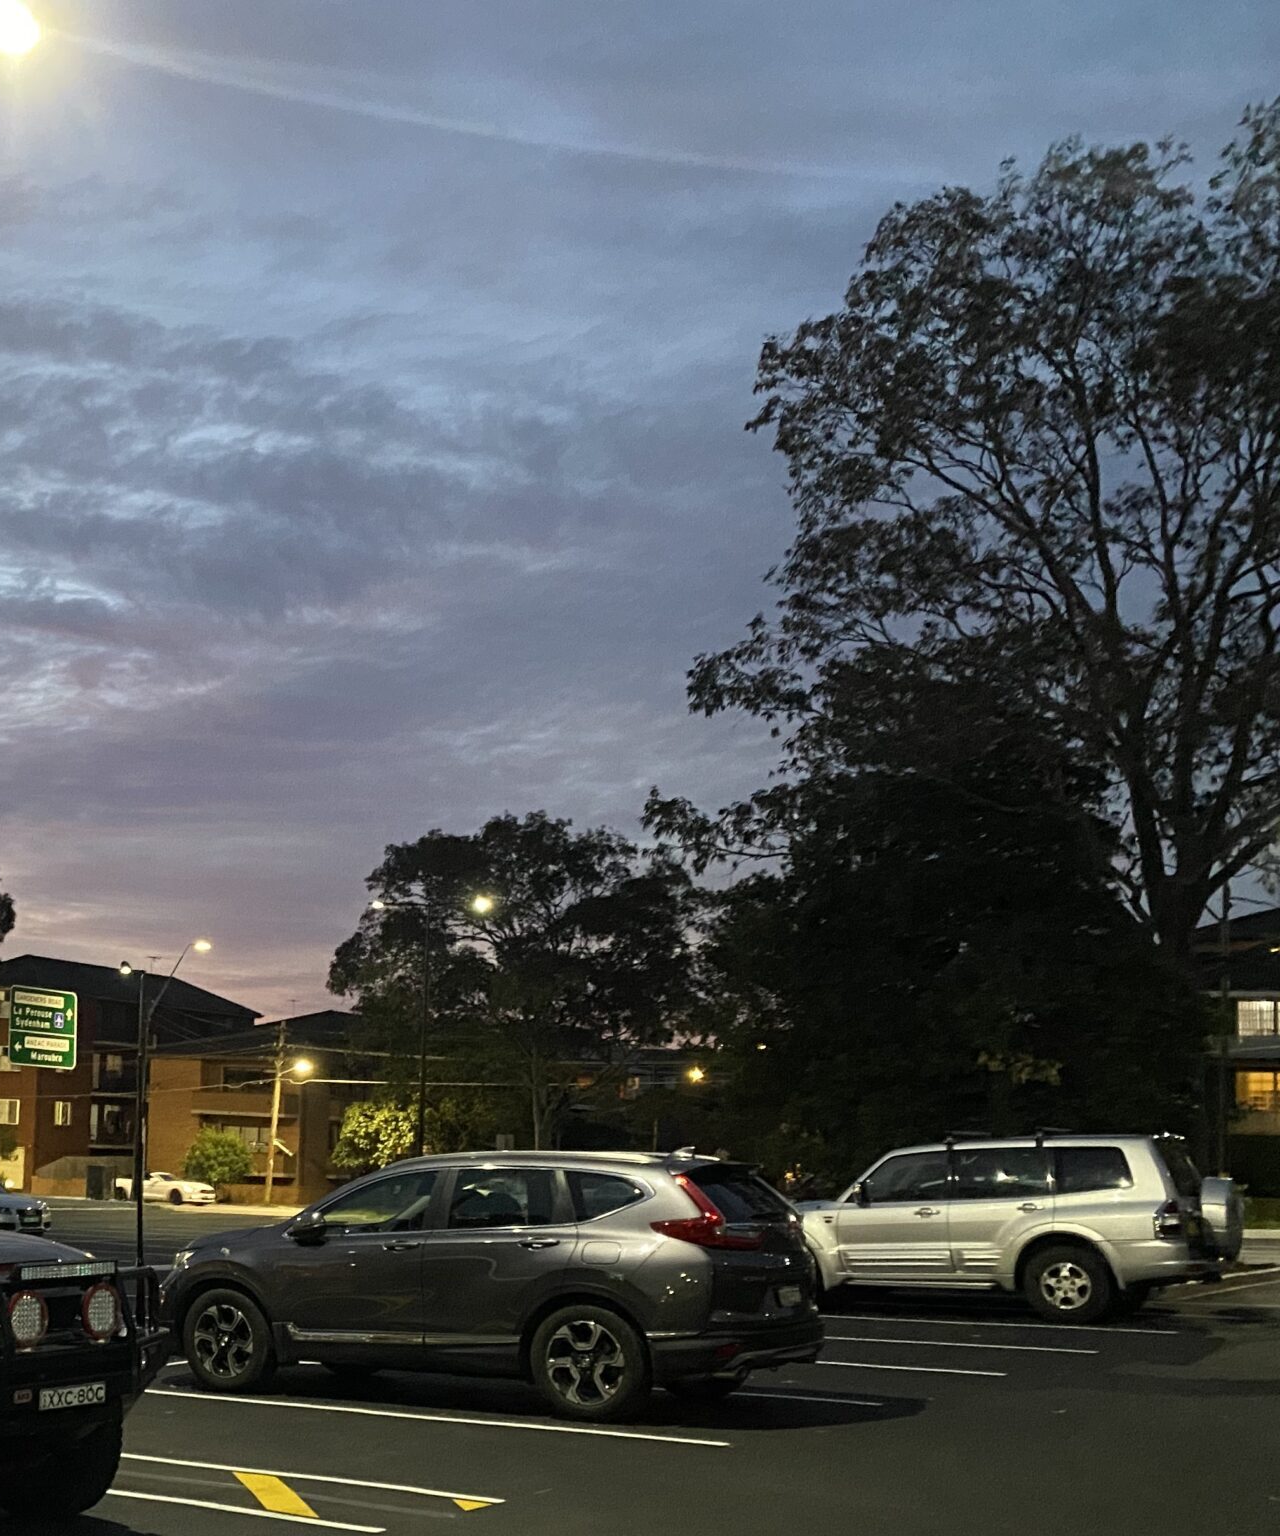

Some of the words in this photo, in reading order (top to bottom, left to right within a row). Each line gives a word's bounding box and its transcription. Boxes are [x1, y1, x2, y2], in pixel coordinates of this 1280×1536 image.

[14, 1006, 22, 1015] La
[26, 1007, 52, 1018] Perouse
[16, 1017, 50, 1029] Sydenham
[31, 1051, 62, 1063] Maroubra
